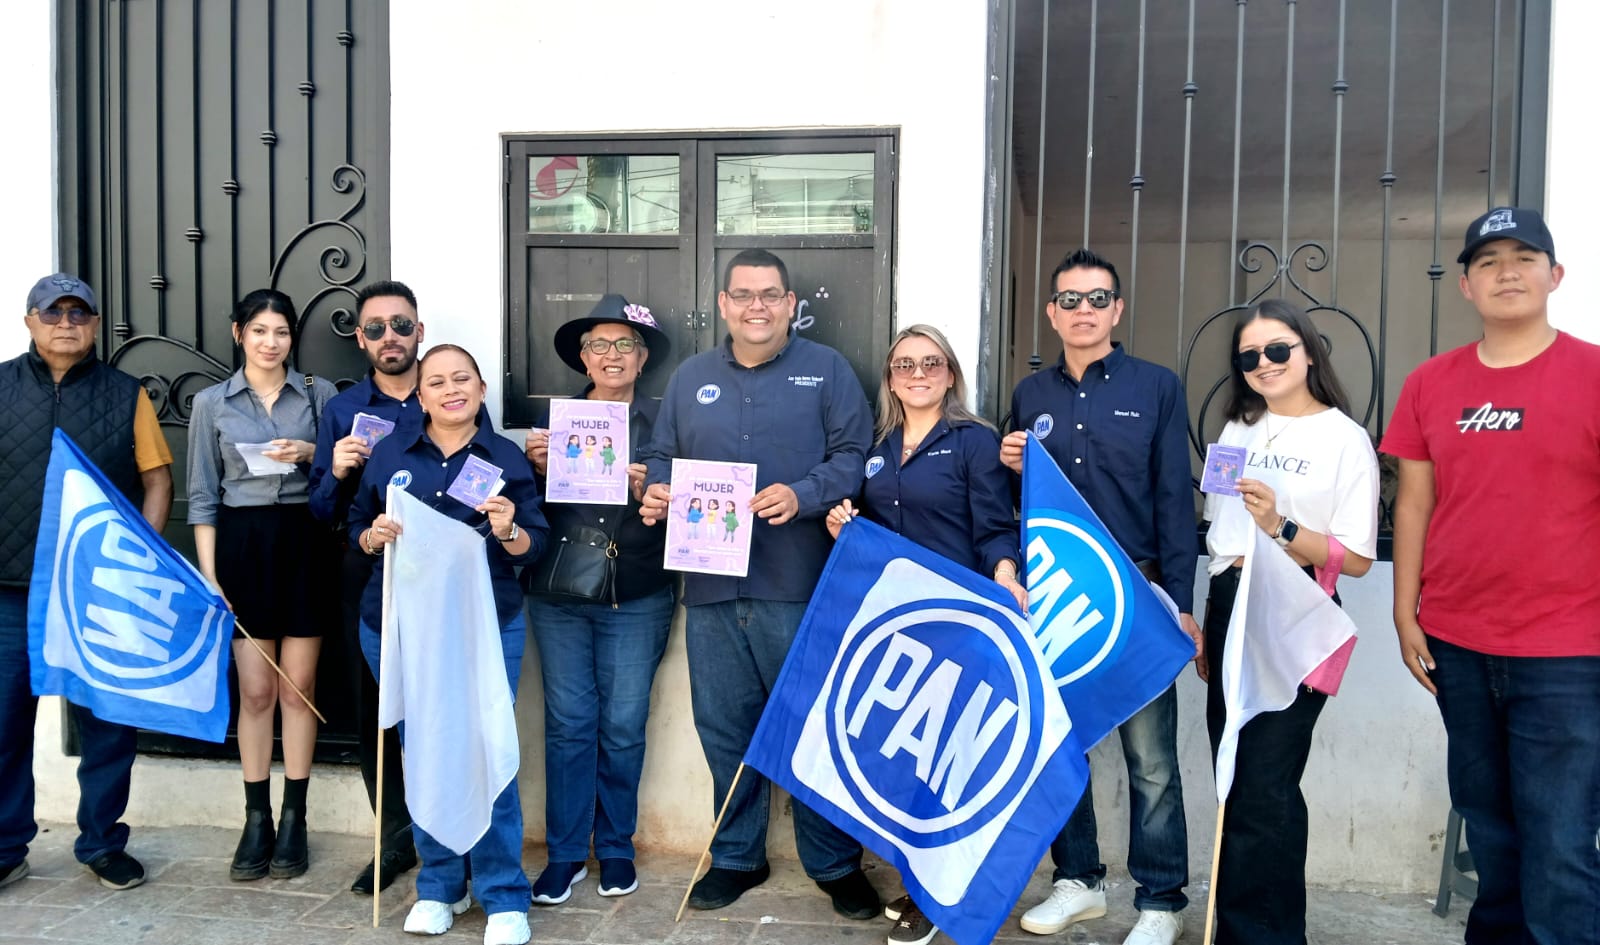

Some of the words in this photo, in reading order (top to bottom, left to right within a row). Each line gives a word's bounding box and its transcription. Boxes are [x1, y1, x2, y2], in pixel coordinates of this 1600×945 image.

[700, 388, 717, 399] PAN
[1455, 401, 1521, 434] Aero
[571, 420, 610, 430] MUJER
[1036, 419, 1050, 434] PAN
[693, 482, 735, 494] MUJER
[846, 631, 1019, 813] PAN
